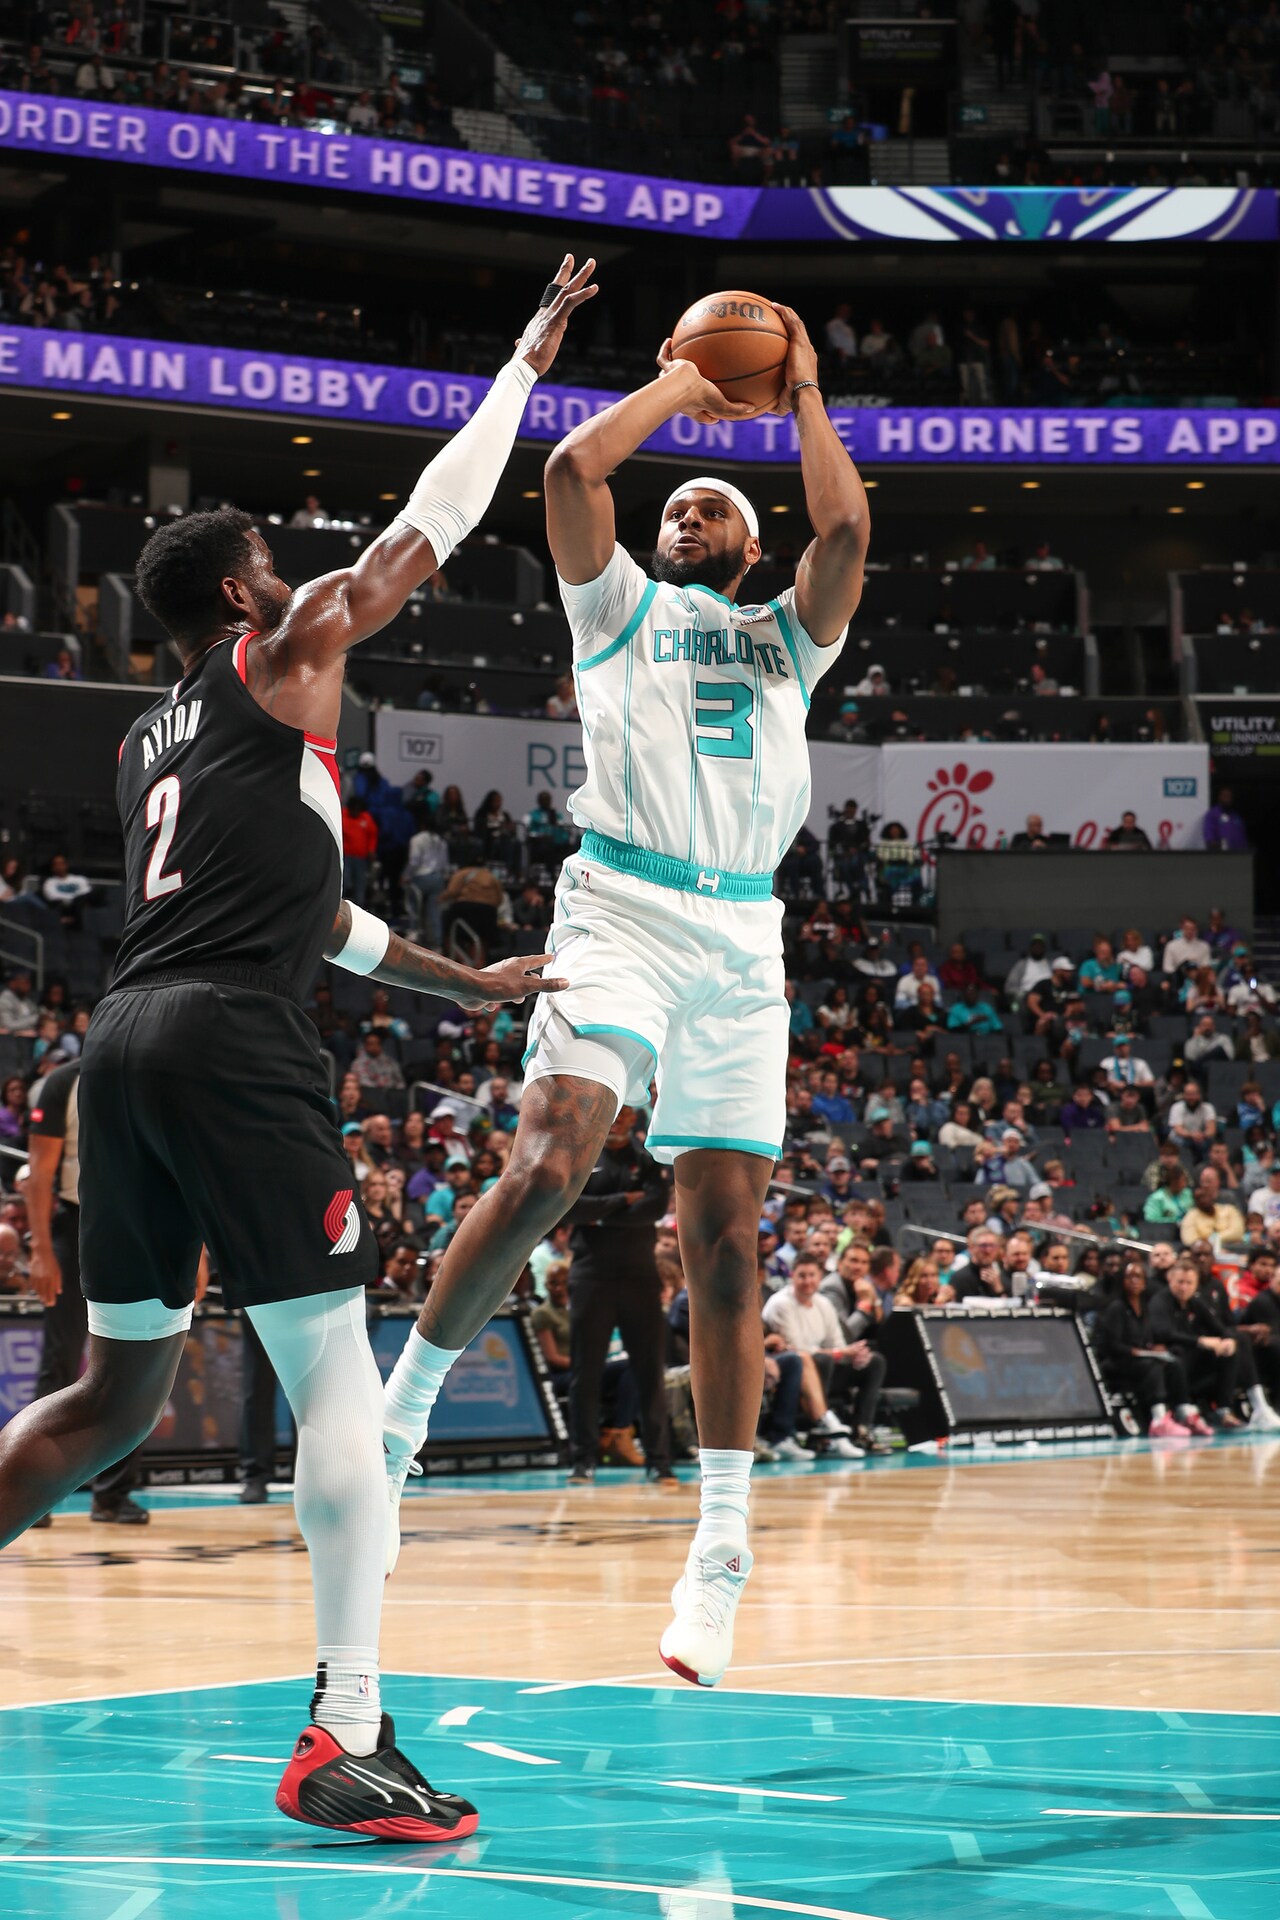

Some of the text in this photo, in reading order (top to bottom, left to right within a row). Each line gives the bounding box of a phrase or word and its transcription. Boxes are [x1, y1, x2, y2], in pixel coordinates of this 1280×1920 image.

[168, 123, 236, 164] ON
[257, 133, 349, 180] THE
[370, 149, 607, 213] HORNETS
[625, 184, 723, 227] APP
[43, 340, 185, 391] MAIN
[210, 357, 388, 411] LOBBY
[407, 380, 475, 422] OR
[671, 412, 735, 449] ON
[878, 417, 1143, 454] HORNETS
[1166, 418, 1277, 454] APP
[141, 700, 203, 771] AYTON
[406, 738, 436, 757] 107
[696, 681, 754, 759] 3
[1211, 716, 1275, 731] UTILITY
[1167, 780, 1194, 795] 107
[144, 774, 183, 903] 2
